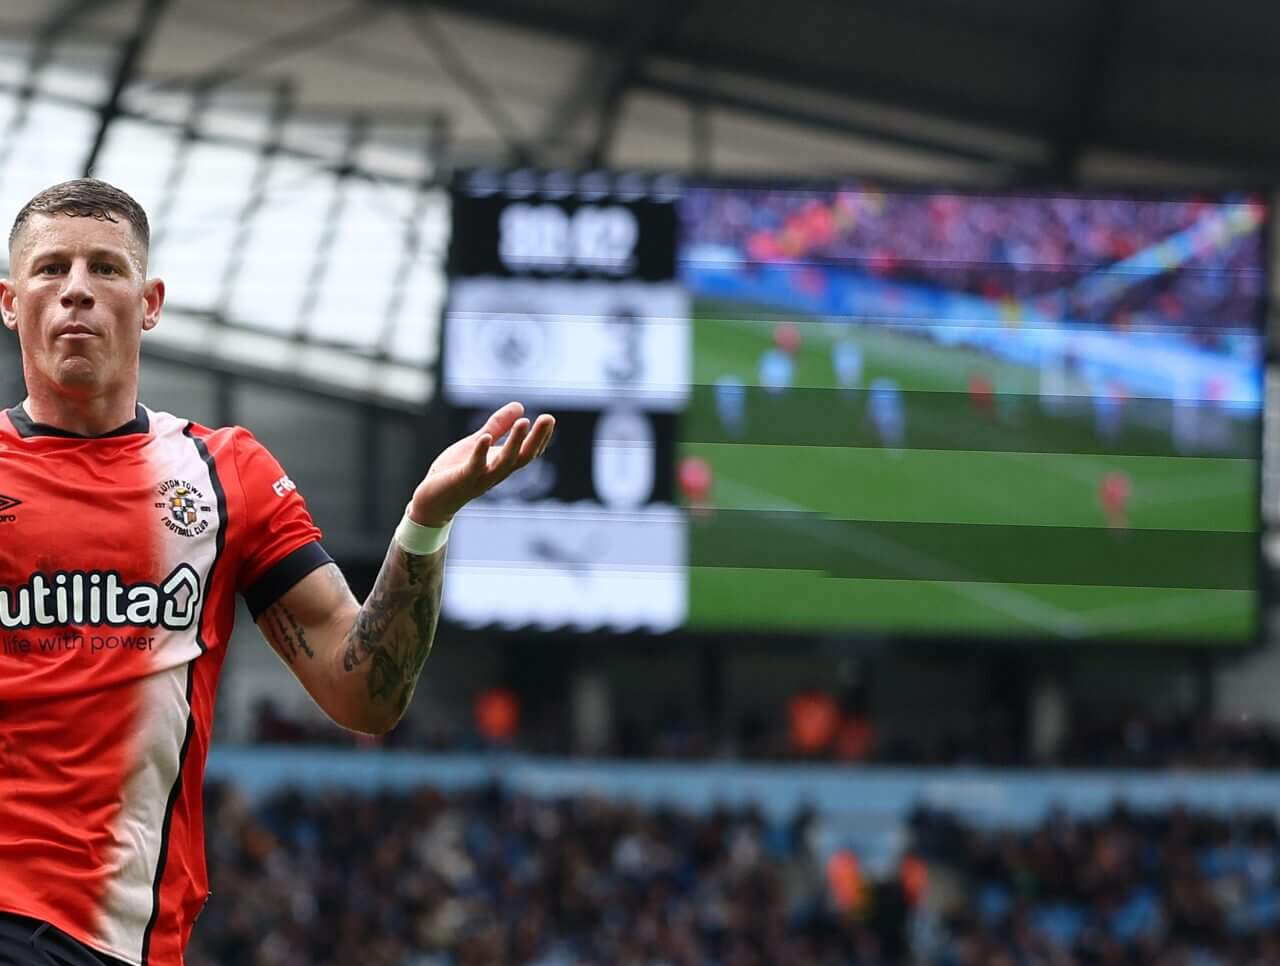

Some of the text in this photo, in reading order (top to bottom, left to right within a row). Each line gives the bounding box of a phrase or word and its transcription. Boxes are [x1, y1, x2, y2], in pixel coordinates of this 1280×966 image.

[606, 305, 645, 382] 3
[592, 412, 655, 506] 0
[158, 479, 203, 498] LUTON TOWN
[161, 516, 209, 538] FOOTBALL CLUB
[2, 629, 156, 655] life with power
